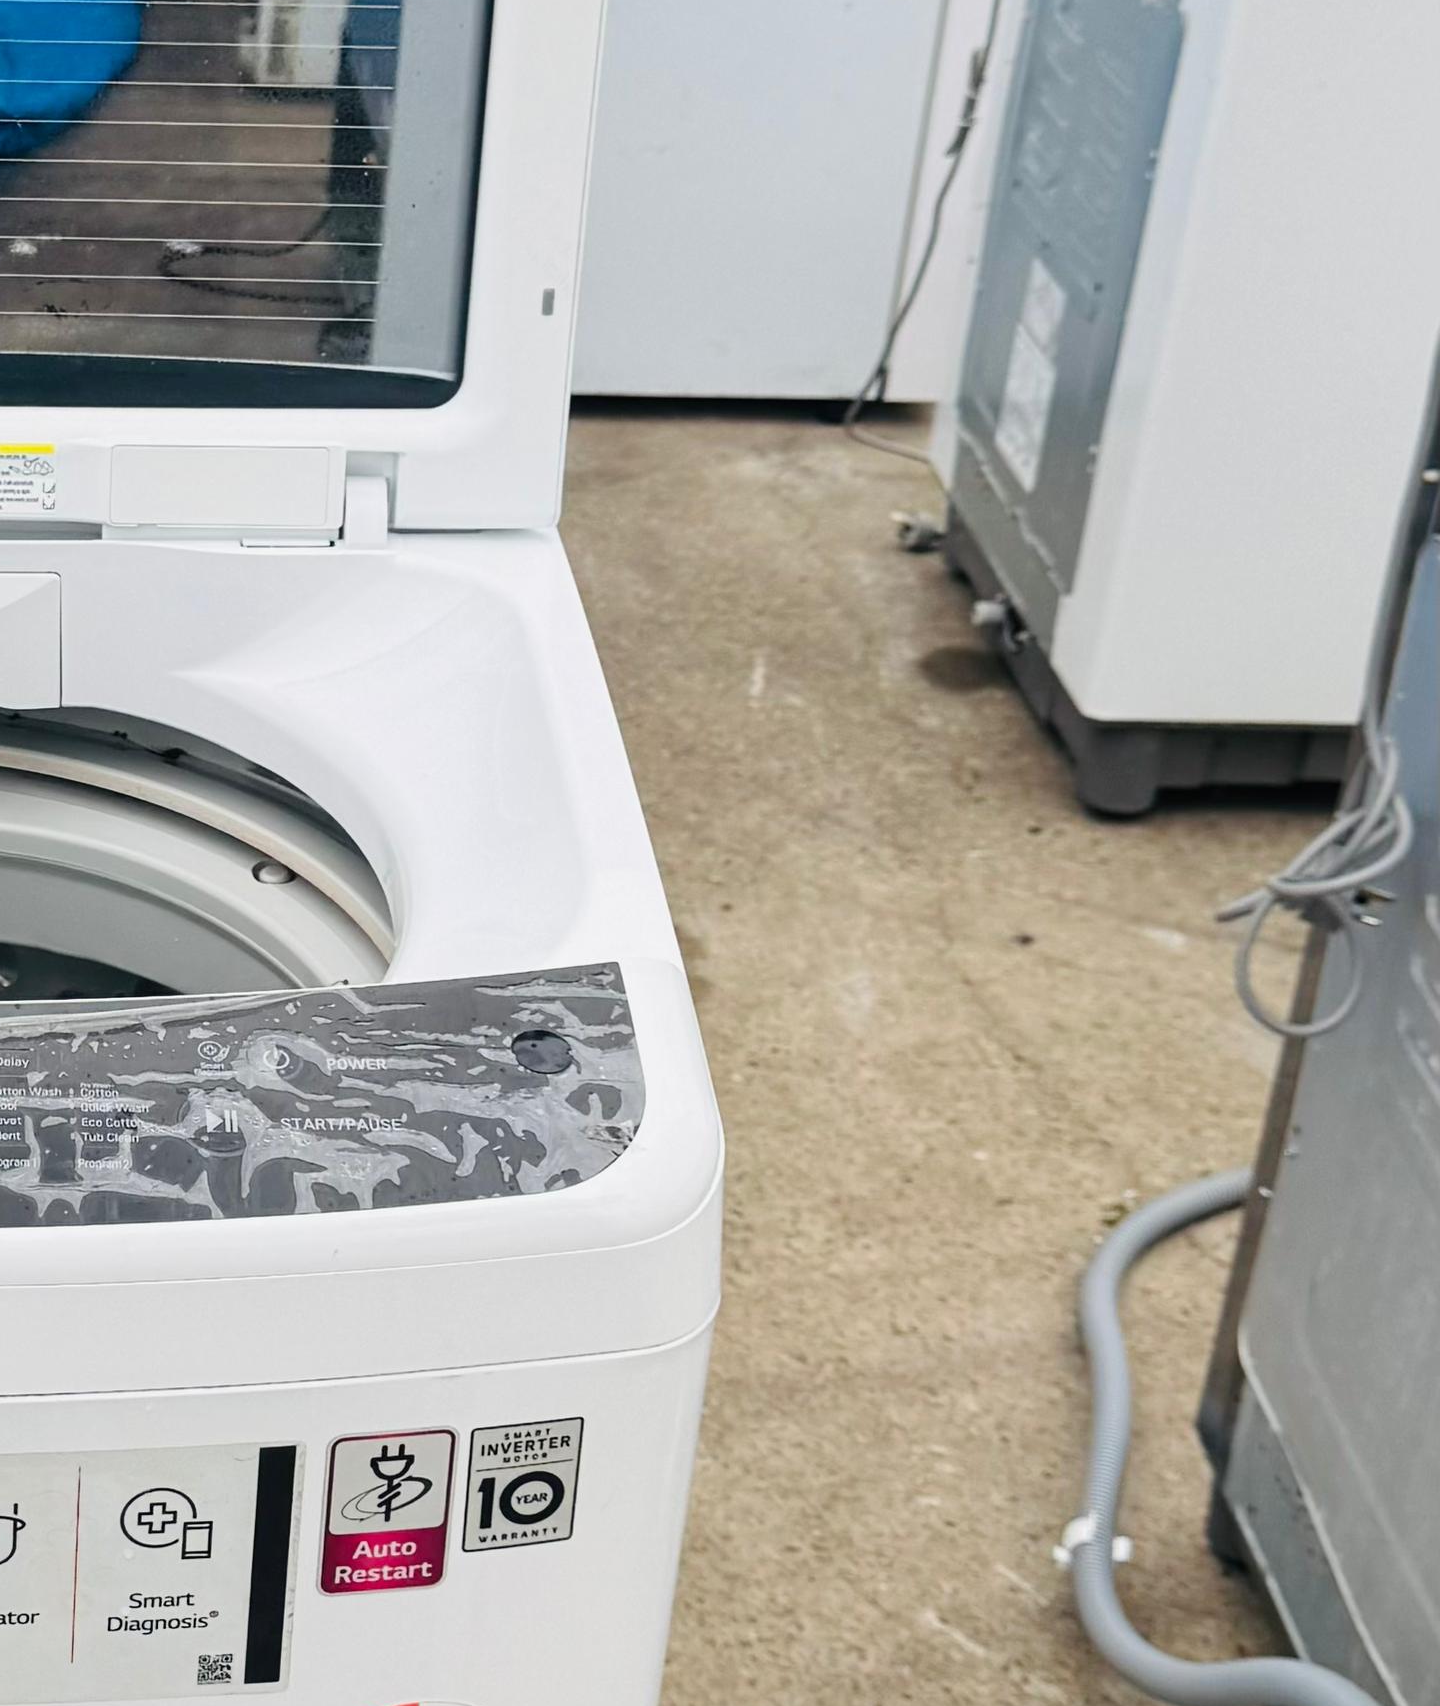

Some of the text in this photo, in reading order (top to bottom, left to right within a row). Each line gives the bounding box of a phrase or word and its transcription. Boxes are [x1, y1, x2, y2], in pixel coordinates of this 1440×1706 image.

[326, 1058, 387, 1070] POWER
[29, 1087, 62, 1097] Wash
[80, 1088, 119, 1098] Cotton
[81, 1117, 143, 1128] Eco Cotto
[280, 1117, 403, 1132] START/PAUSE
[81, 1132, 103, 1142] Tub
[504, 1428, 551, 1441] SMART
[481, 1435, 571, 1457] INVERTER
[503, 1452, 548, 1463] MOTOR
[477, 1471, 565, 1529] 10
[516, 1493, 548, 1505] YEAR
[479, 1527, 558, 1543] WARRANTY
[352, 1540, 417, 1560] Auto
[334, 1562, 432, 1585] Restart
[128, 1592, 195, 1610] Smart
